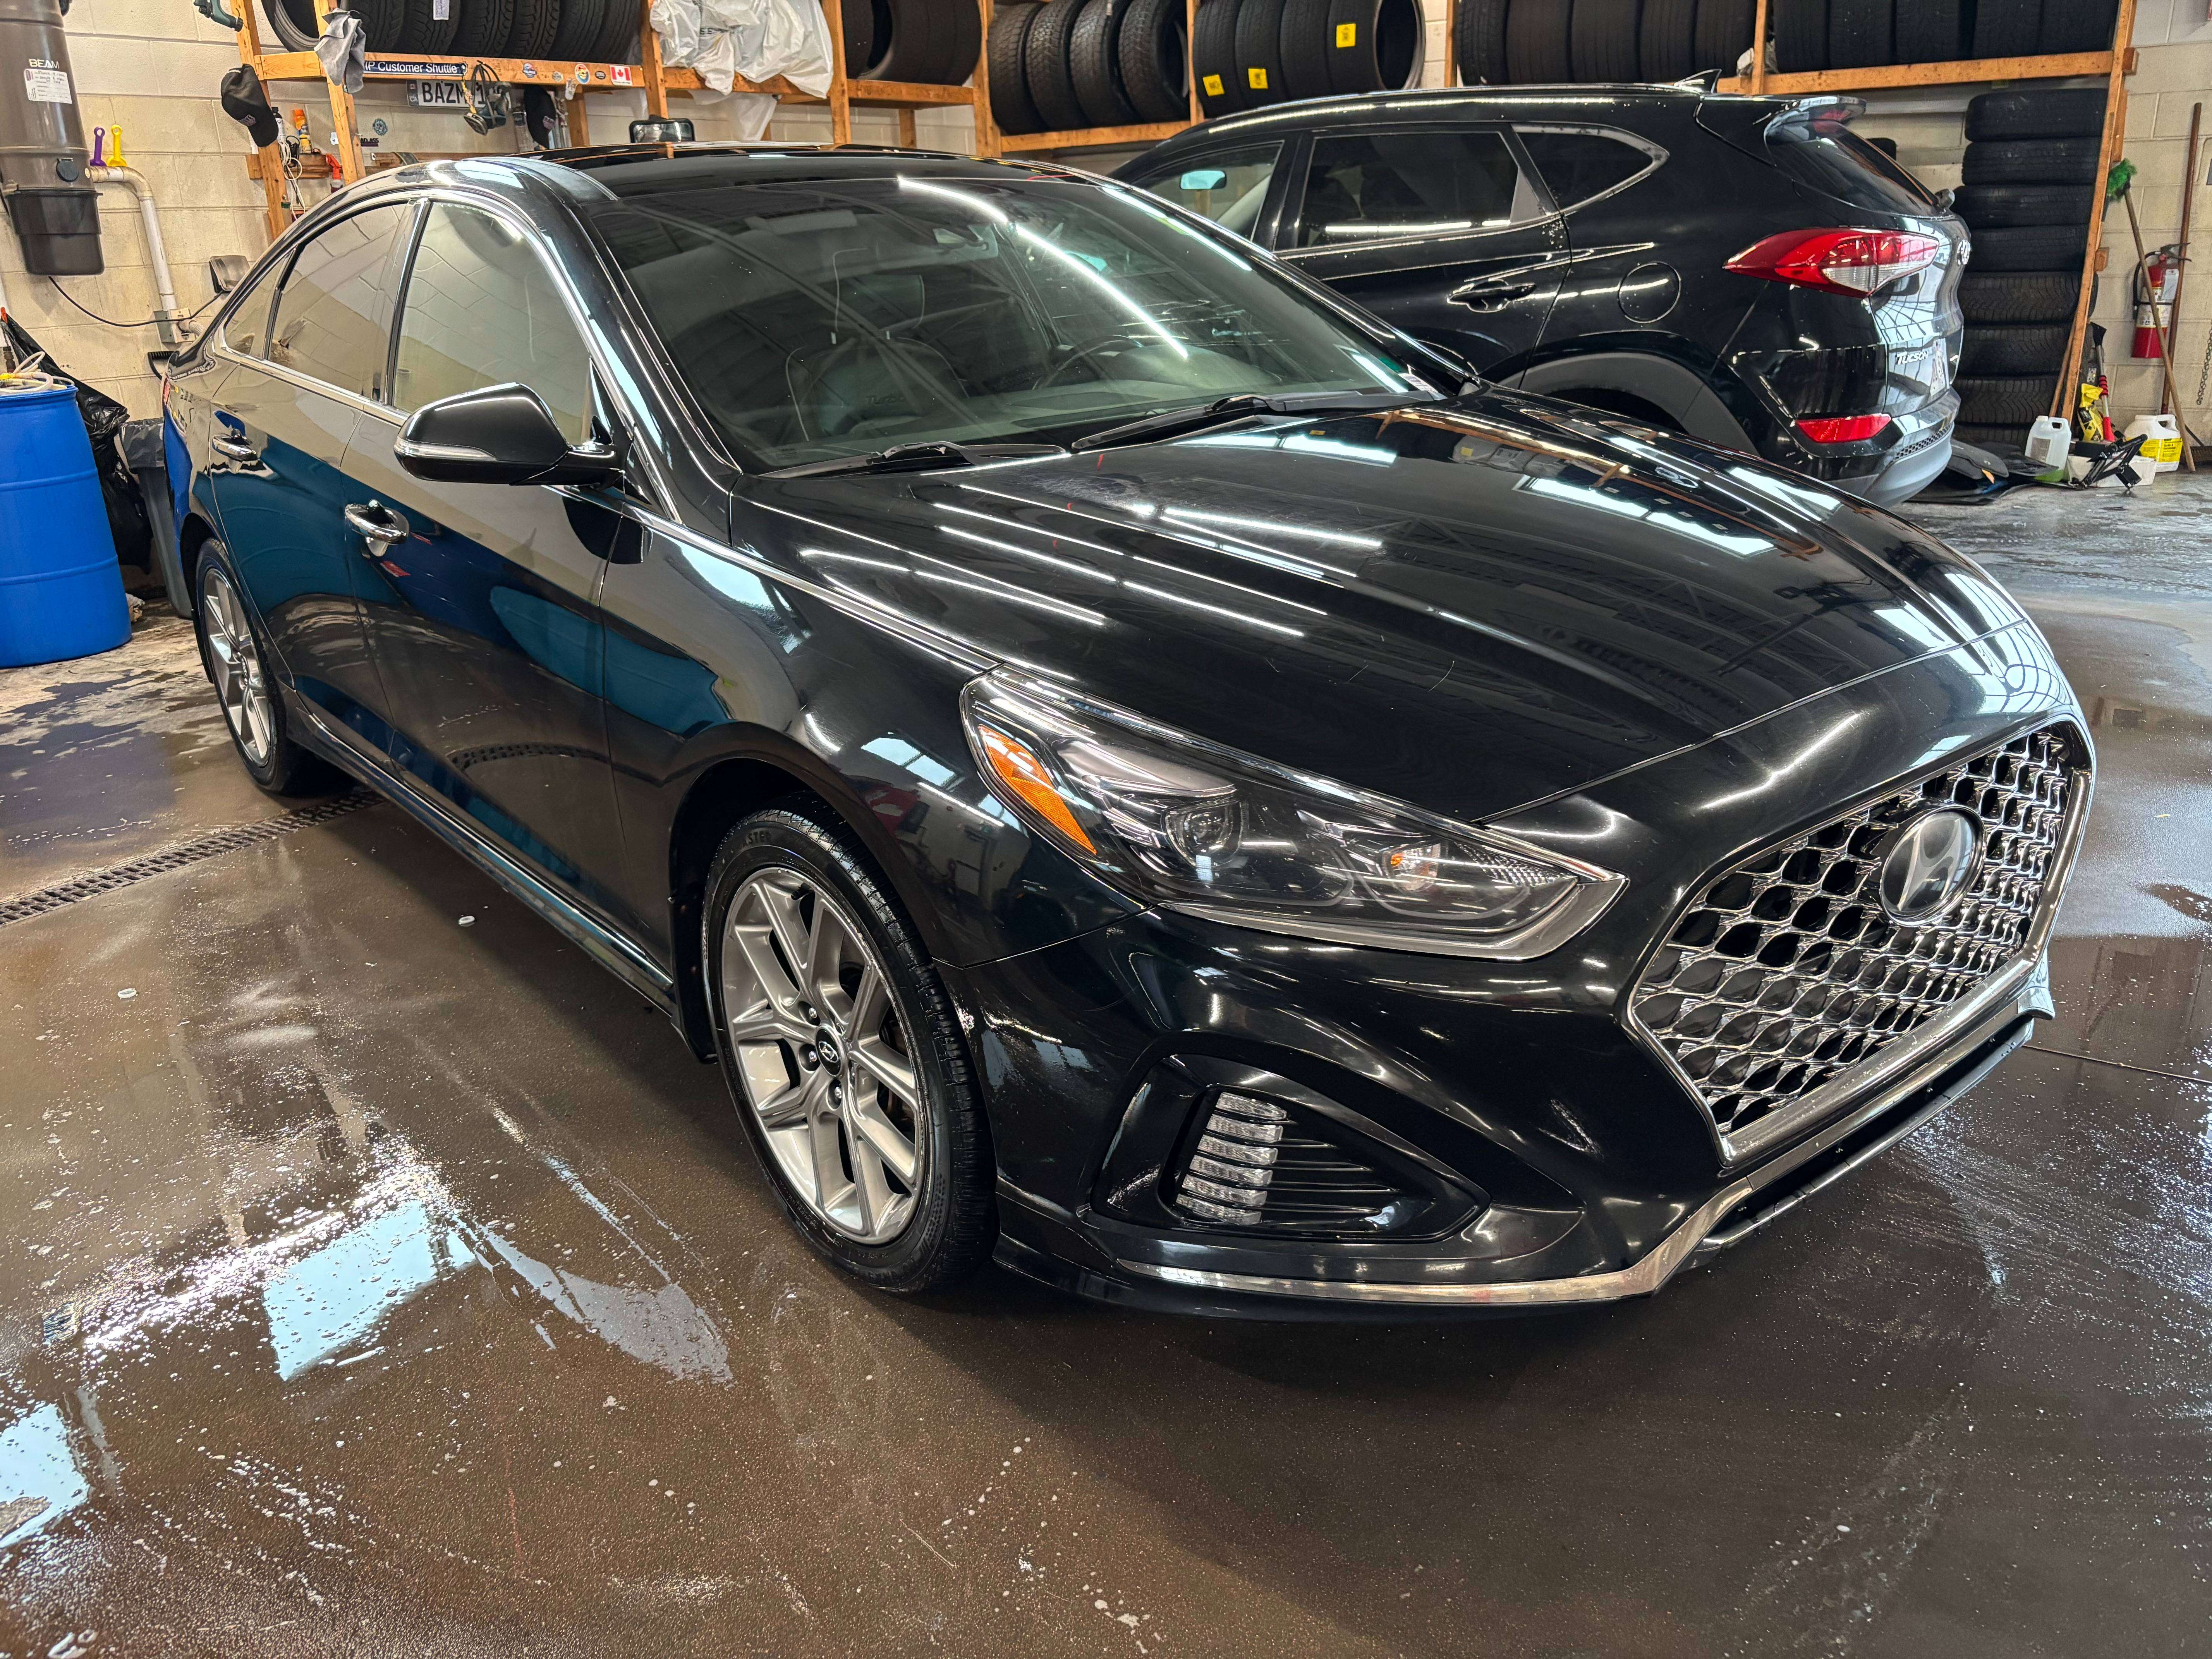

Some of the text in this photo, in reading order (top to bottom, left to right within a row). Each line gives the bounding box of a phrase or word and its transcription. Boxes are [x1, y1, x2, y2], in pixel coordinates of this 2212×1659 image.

[29, 58, 60, 69] BEAM
[365, 61, 457, 74] IP Customer Shuttle
